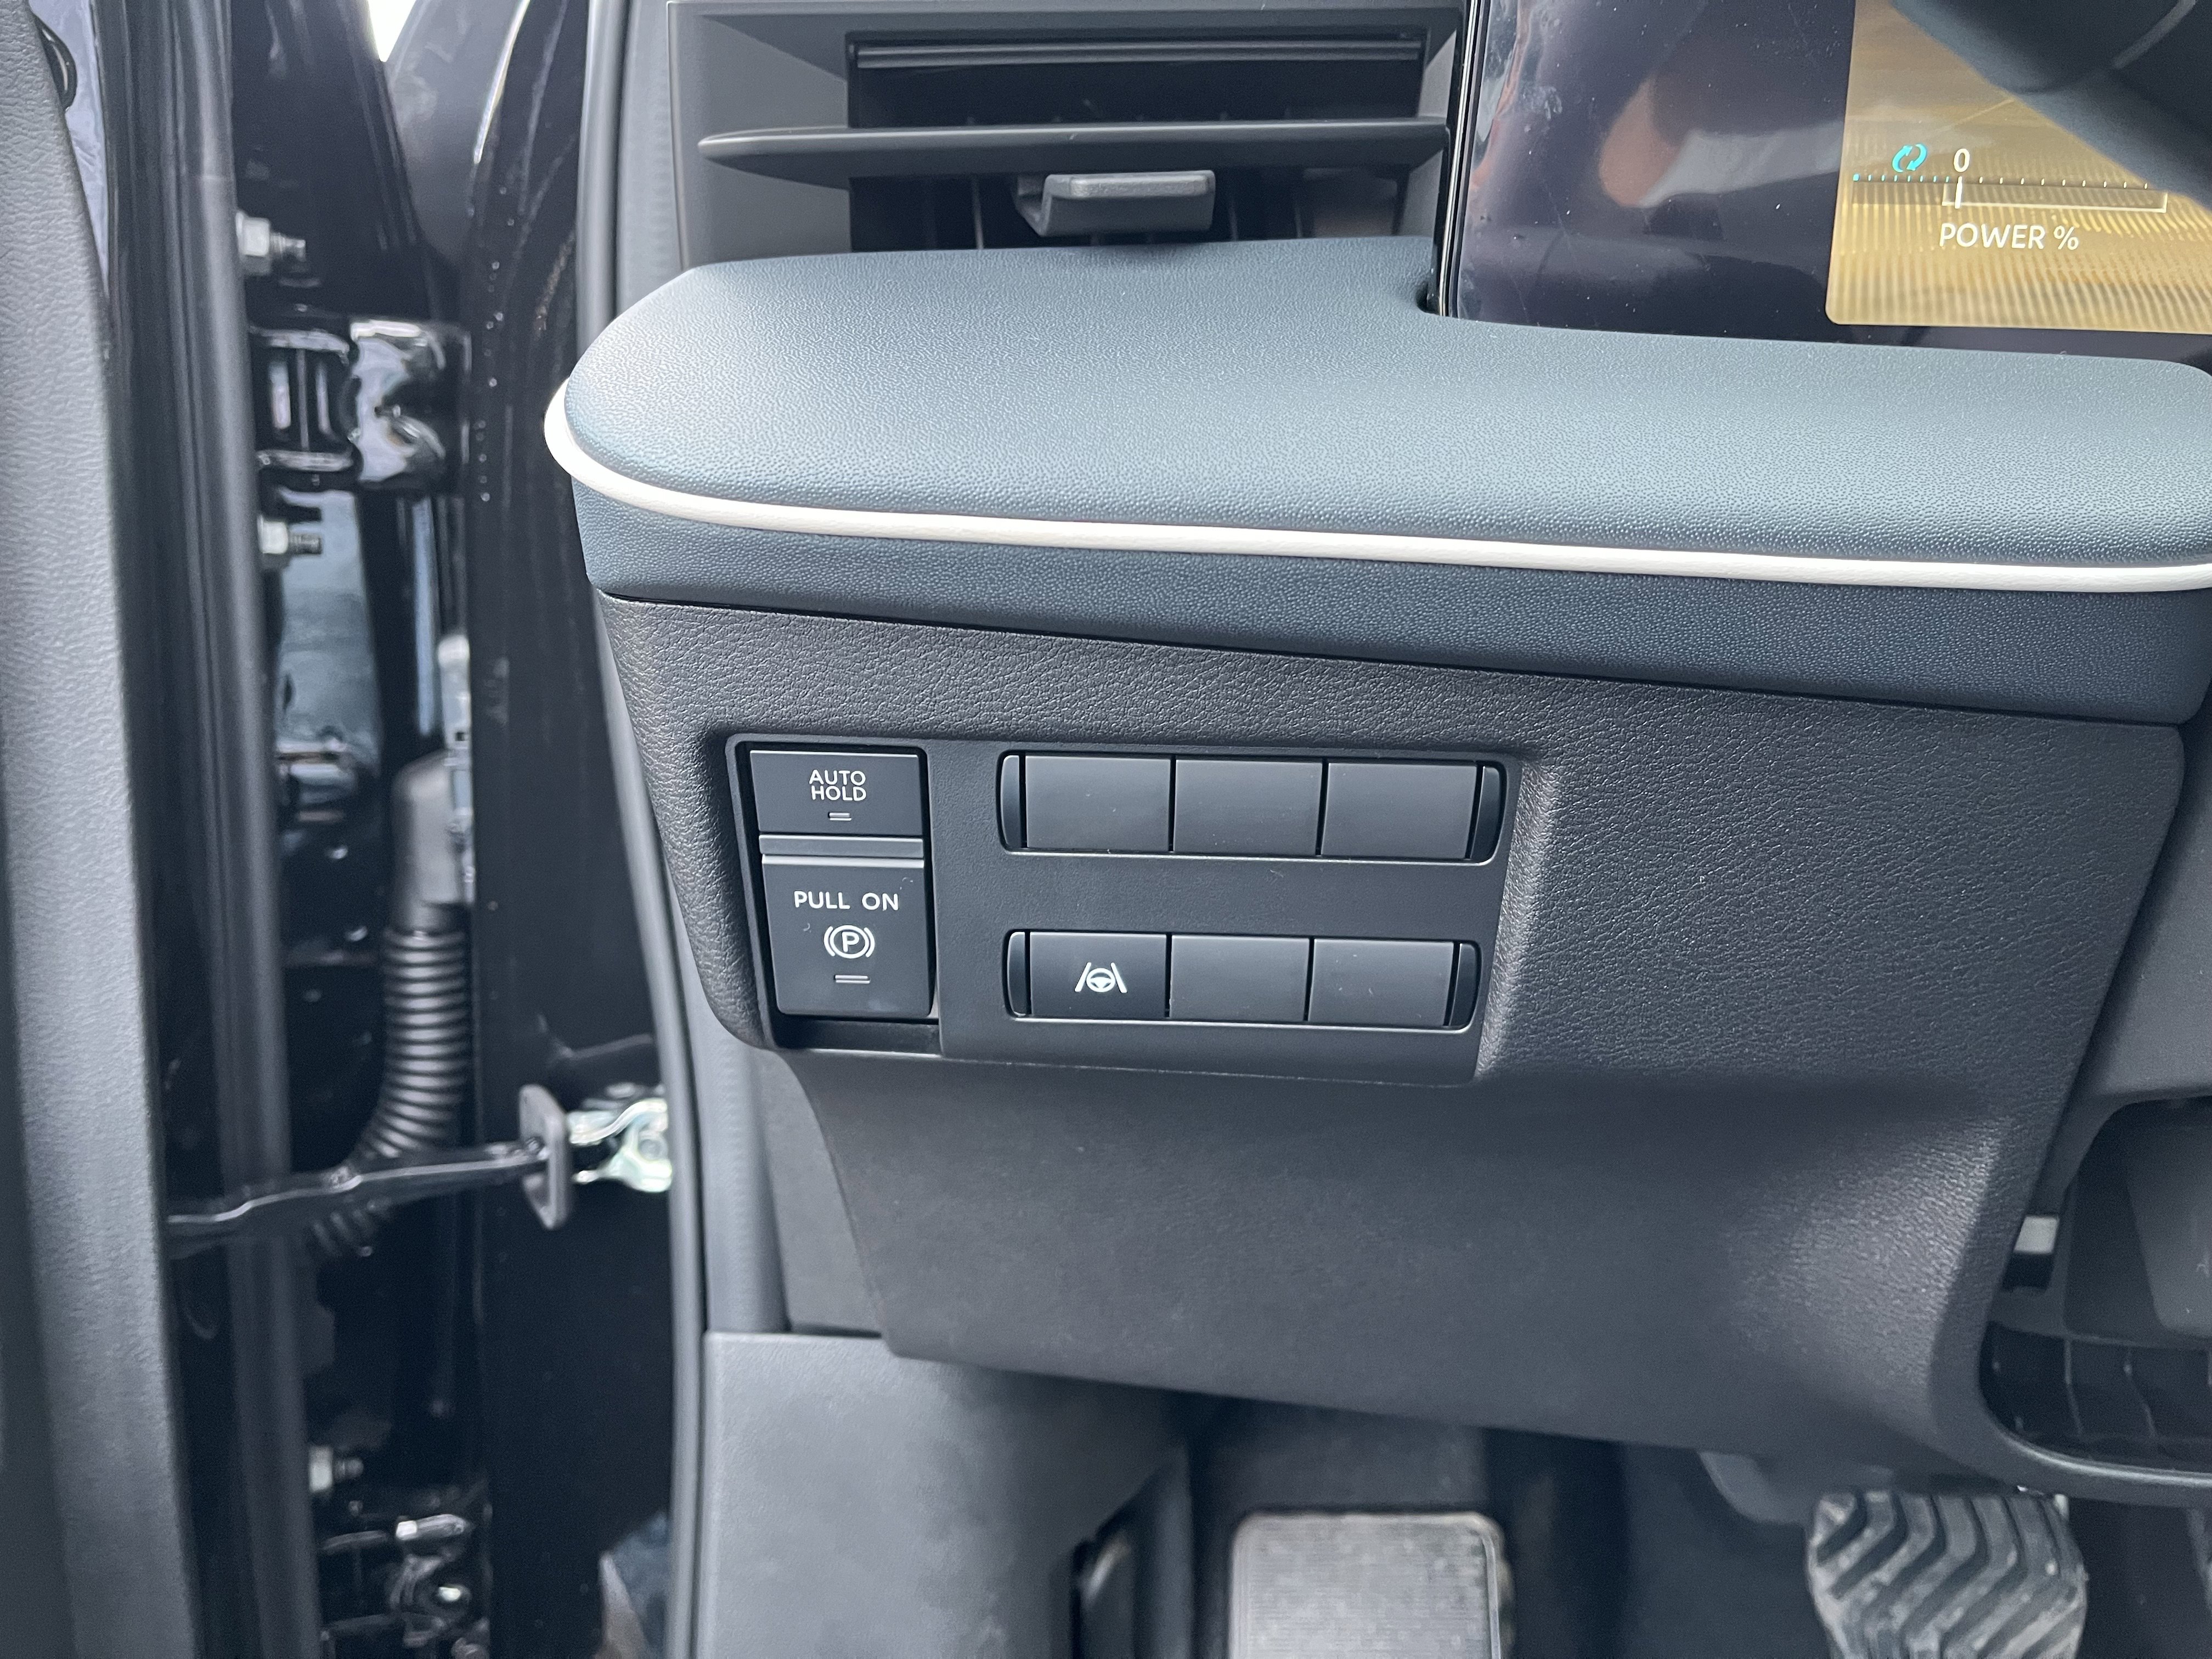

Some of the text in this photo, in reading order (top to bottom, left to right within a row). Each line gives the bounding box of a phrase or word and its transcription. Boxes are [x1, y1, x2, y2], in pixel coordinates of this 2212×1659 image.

[1953, 148, 1970, 173] 0
[1939, 222, 2079, 250] POWER %
[809, 769, 866, 786] AUTO
[811, 785, 867, 802] HOLD
[794, 890, 899, 911] PULL ON
